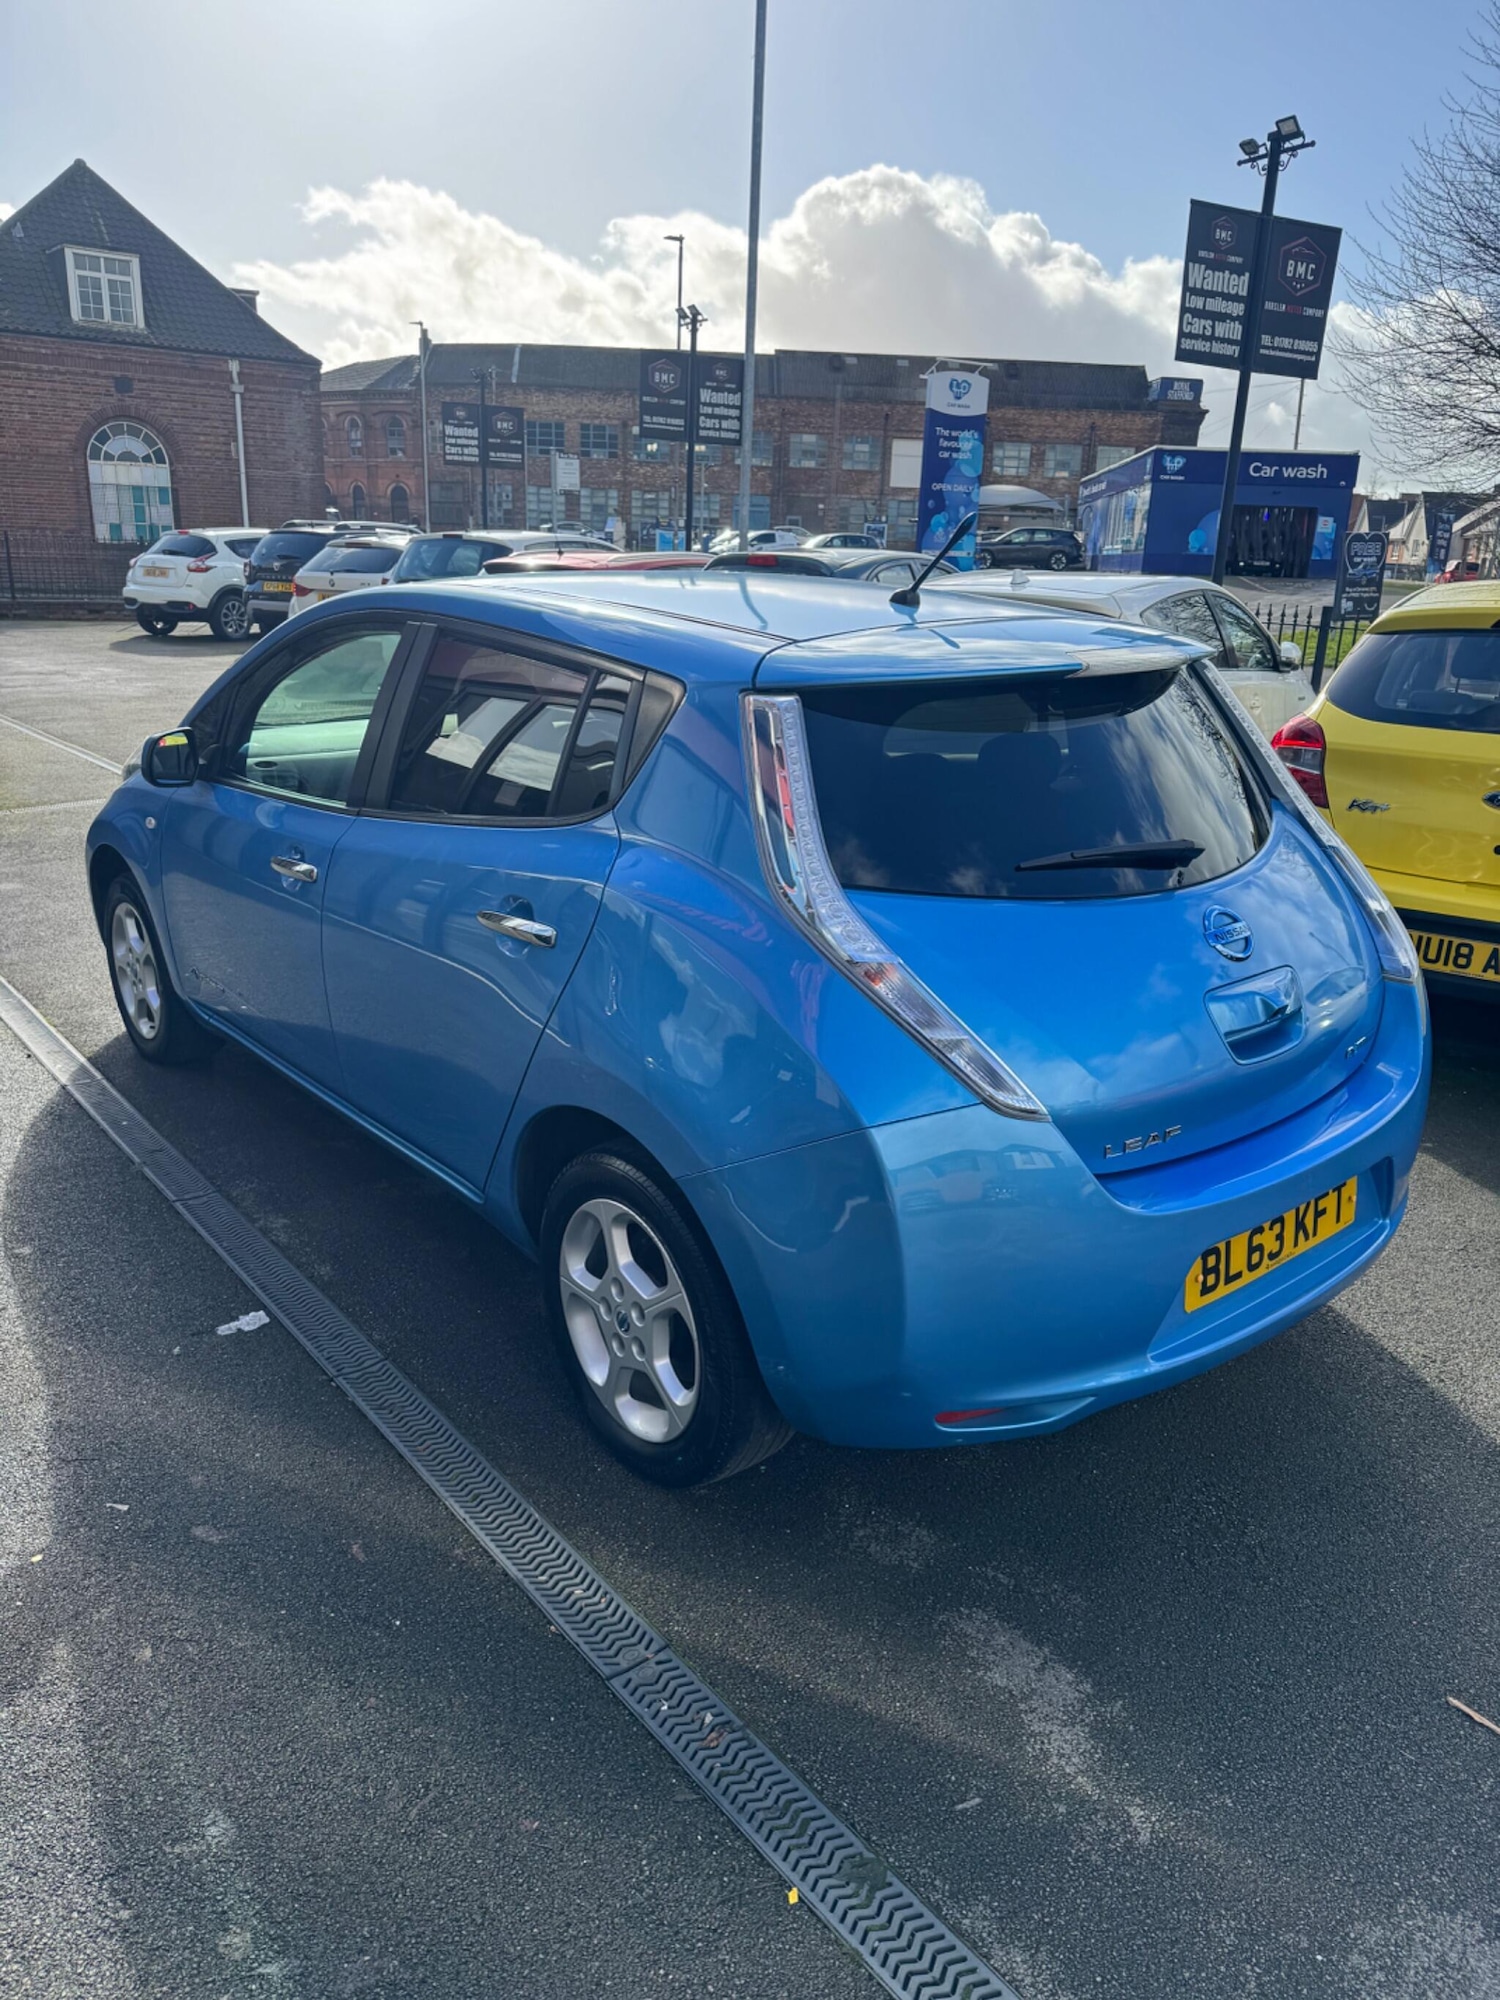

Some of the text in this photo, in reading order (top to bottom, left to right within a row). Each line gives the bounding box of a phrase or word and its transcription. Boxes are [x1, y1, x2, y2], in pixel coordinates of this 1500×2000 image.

[1215, 229, 1232, 241] BMC
[1187, 261, 1250, 297] Wanted
[1286, 260, 1316, 280] BMC
[1185, 292, 1246, 317] Low mileage
[1182, 312, 1243, 340] Cars with
[1180, 337, 1240, 358] service history
[654, 371, 676, 384] BMC
[699, 387, 742, 406] Wanted
[444, 424, 479, 438] Wanted
[699, 416, 720, 429] Cars
[721, 418, 740, 430] with
[935, 426, 979, 440] The world's
[938, 450, 973, 460] car wash
[1249, 461, 1328, 479] Car wash
[931, 482, 975, 493] OPEN DAILY
[1350, 541, 1382, 556] FREE
[1214, 923, 1249, 941] NISSAN
[1104, 1124, 1182, 1159] LEAF
[1200, 1181, 1347, 1297] BL63 KFT
